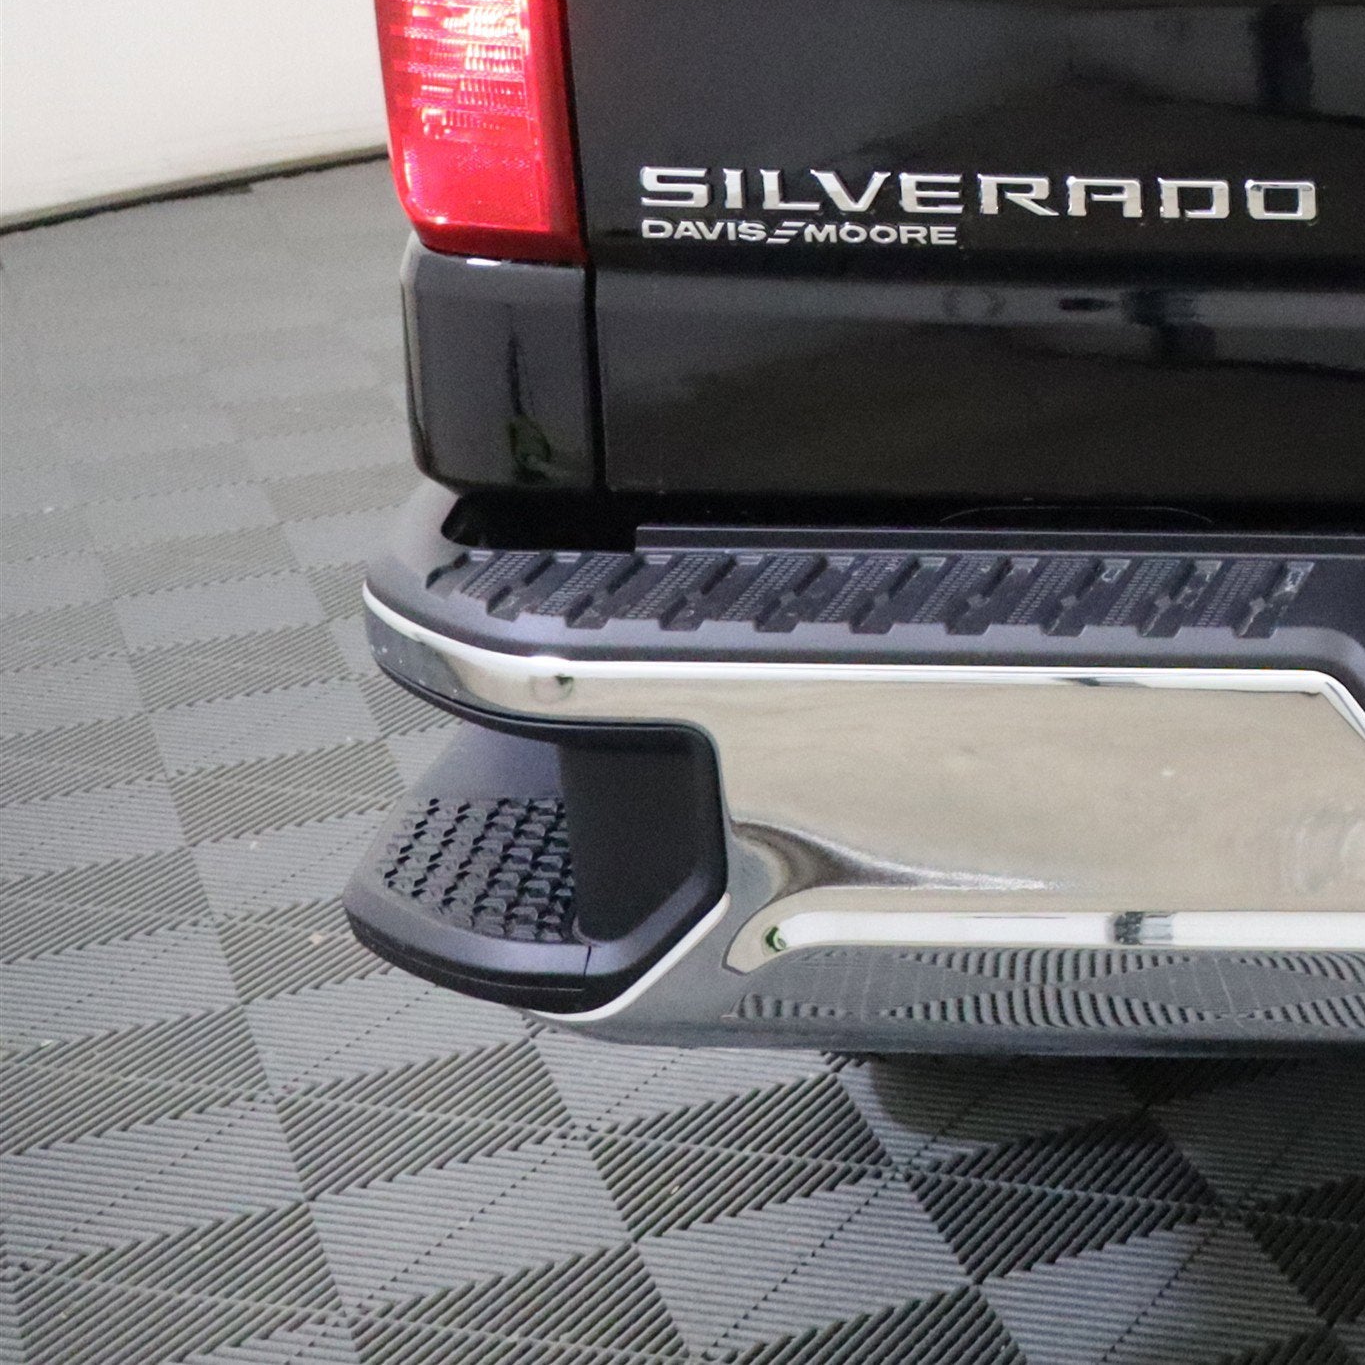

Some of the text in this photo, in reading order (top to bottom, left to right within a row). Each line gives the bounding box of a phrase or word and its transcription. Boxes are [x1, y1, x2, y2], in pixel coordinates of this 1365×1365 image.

[640, 166, 1317, 221] SILVERADO
[640, 219, 958, 246] DAVIS MOORE
